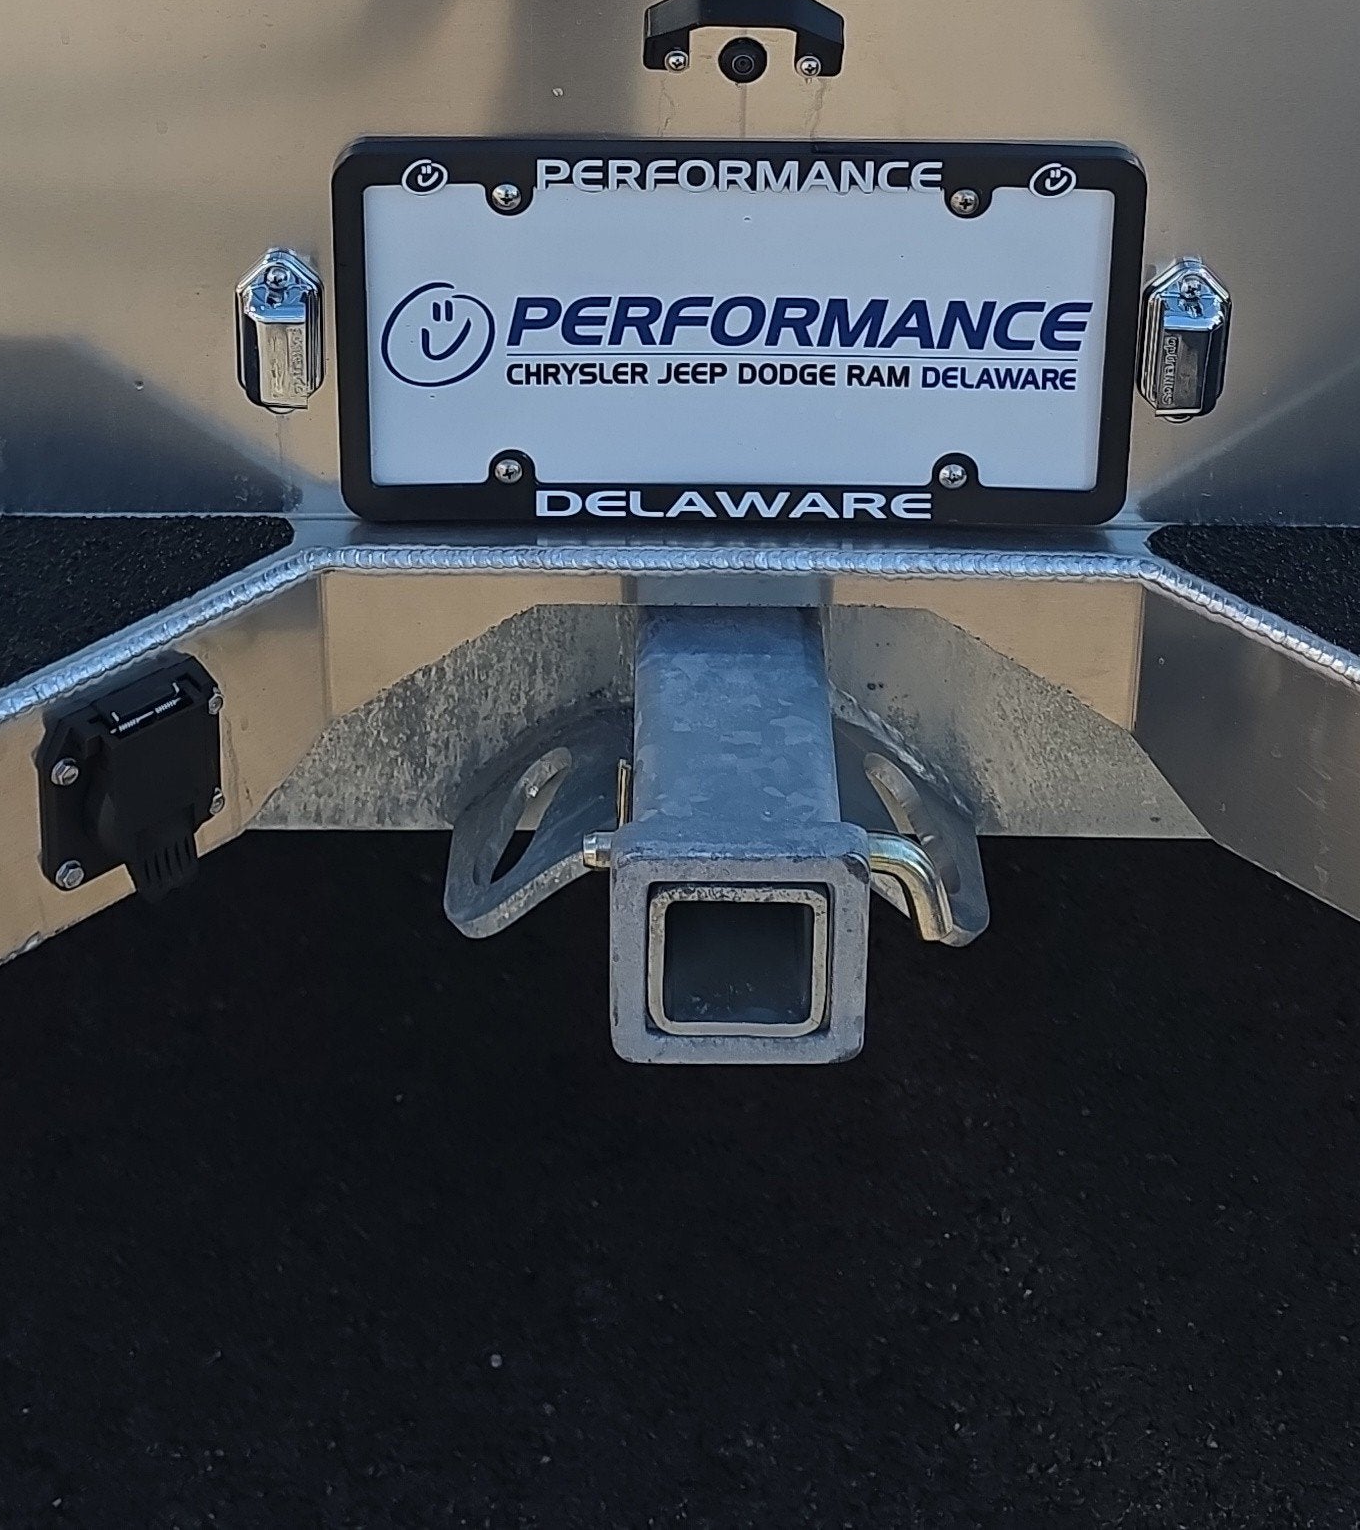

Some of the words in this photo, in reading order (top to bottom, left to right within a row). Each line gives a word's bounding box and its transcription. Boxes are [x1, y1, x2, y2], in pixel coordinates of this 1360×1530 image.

[535, 158, 946, 194] PERFORMANCE
[506, 295, 1093, 352] PERFORMANCE
[506, 361, 649, 387] CHRYSLER
[657, 362, 728, 386] JEEP
[738, 362, 838, 387] DODGE
[846, 364, 912, 388] RAM
[920, 365, 1078, 391] DELAWARE
[535, 490, 934, 521] DELAWARE
